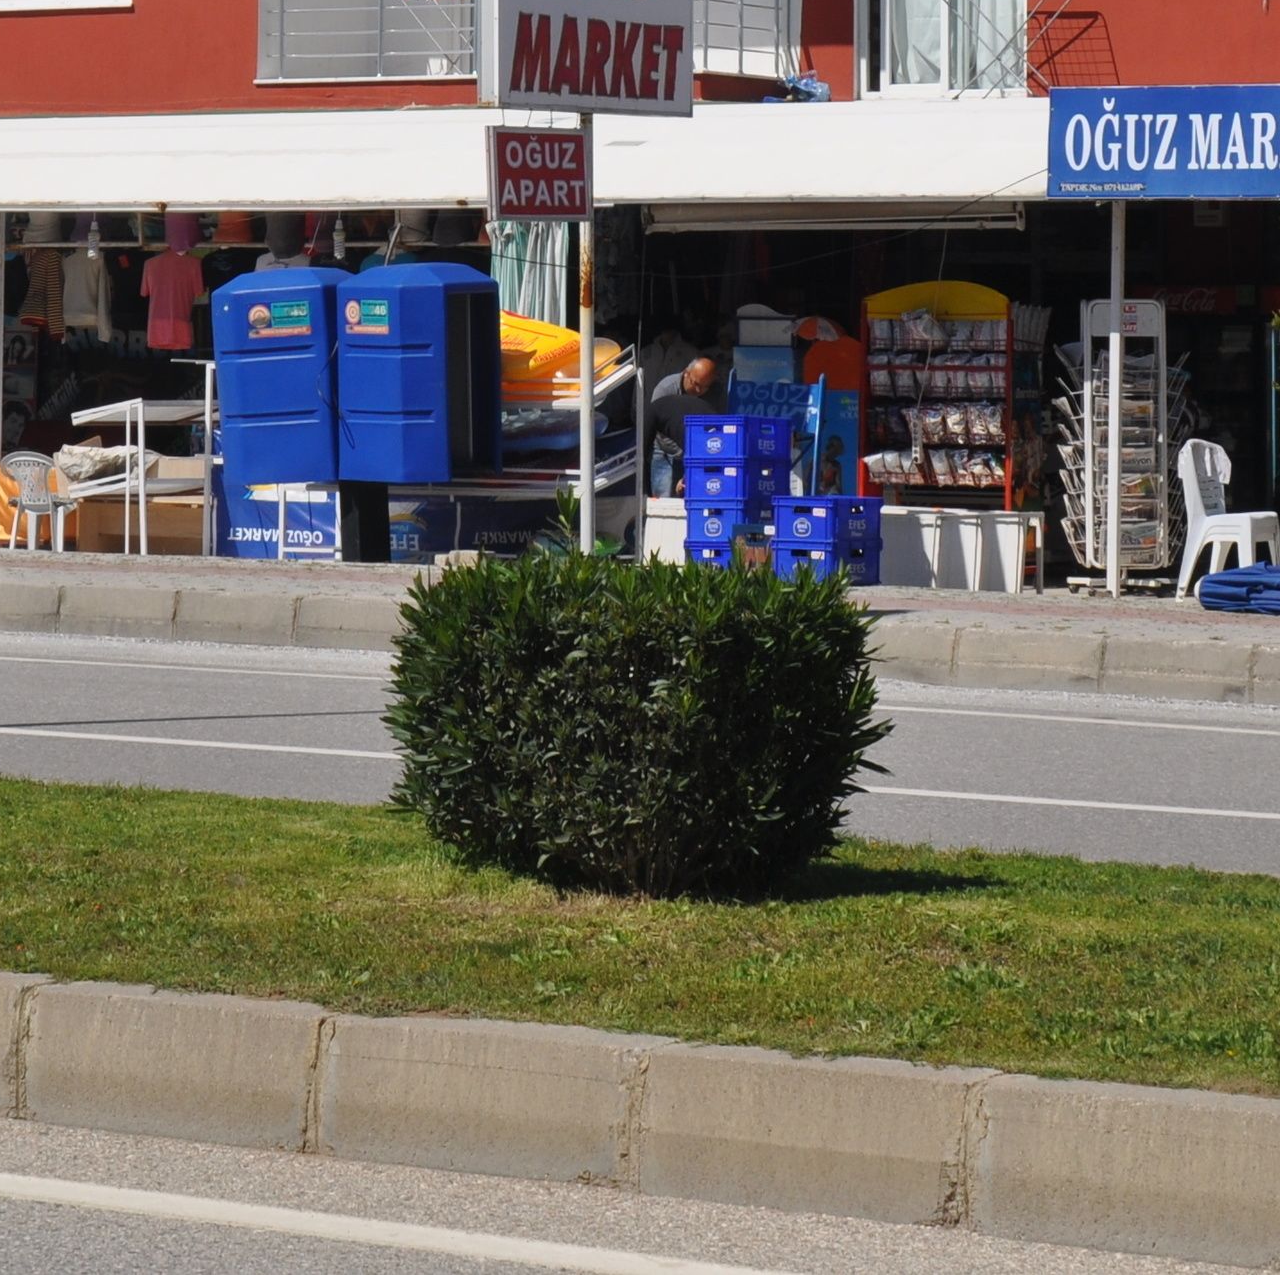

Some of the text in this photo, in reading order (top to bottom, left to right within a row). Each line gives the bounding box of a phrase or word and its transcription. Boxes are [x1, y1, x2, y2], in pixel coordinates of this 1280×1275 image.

[509, 10, 685, 101] MARKET
[1064, 97, 1179, 172] OĞUZ
[505, 135, 577, 170] OĞUZ
[501, 179, 585, 207] APART
[287, 529, 324, 547] OĞUZ
[390, 534, 420, 551] EFE
[472, 530, 534, 546] MARKET
